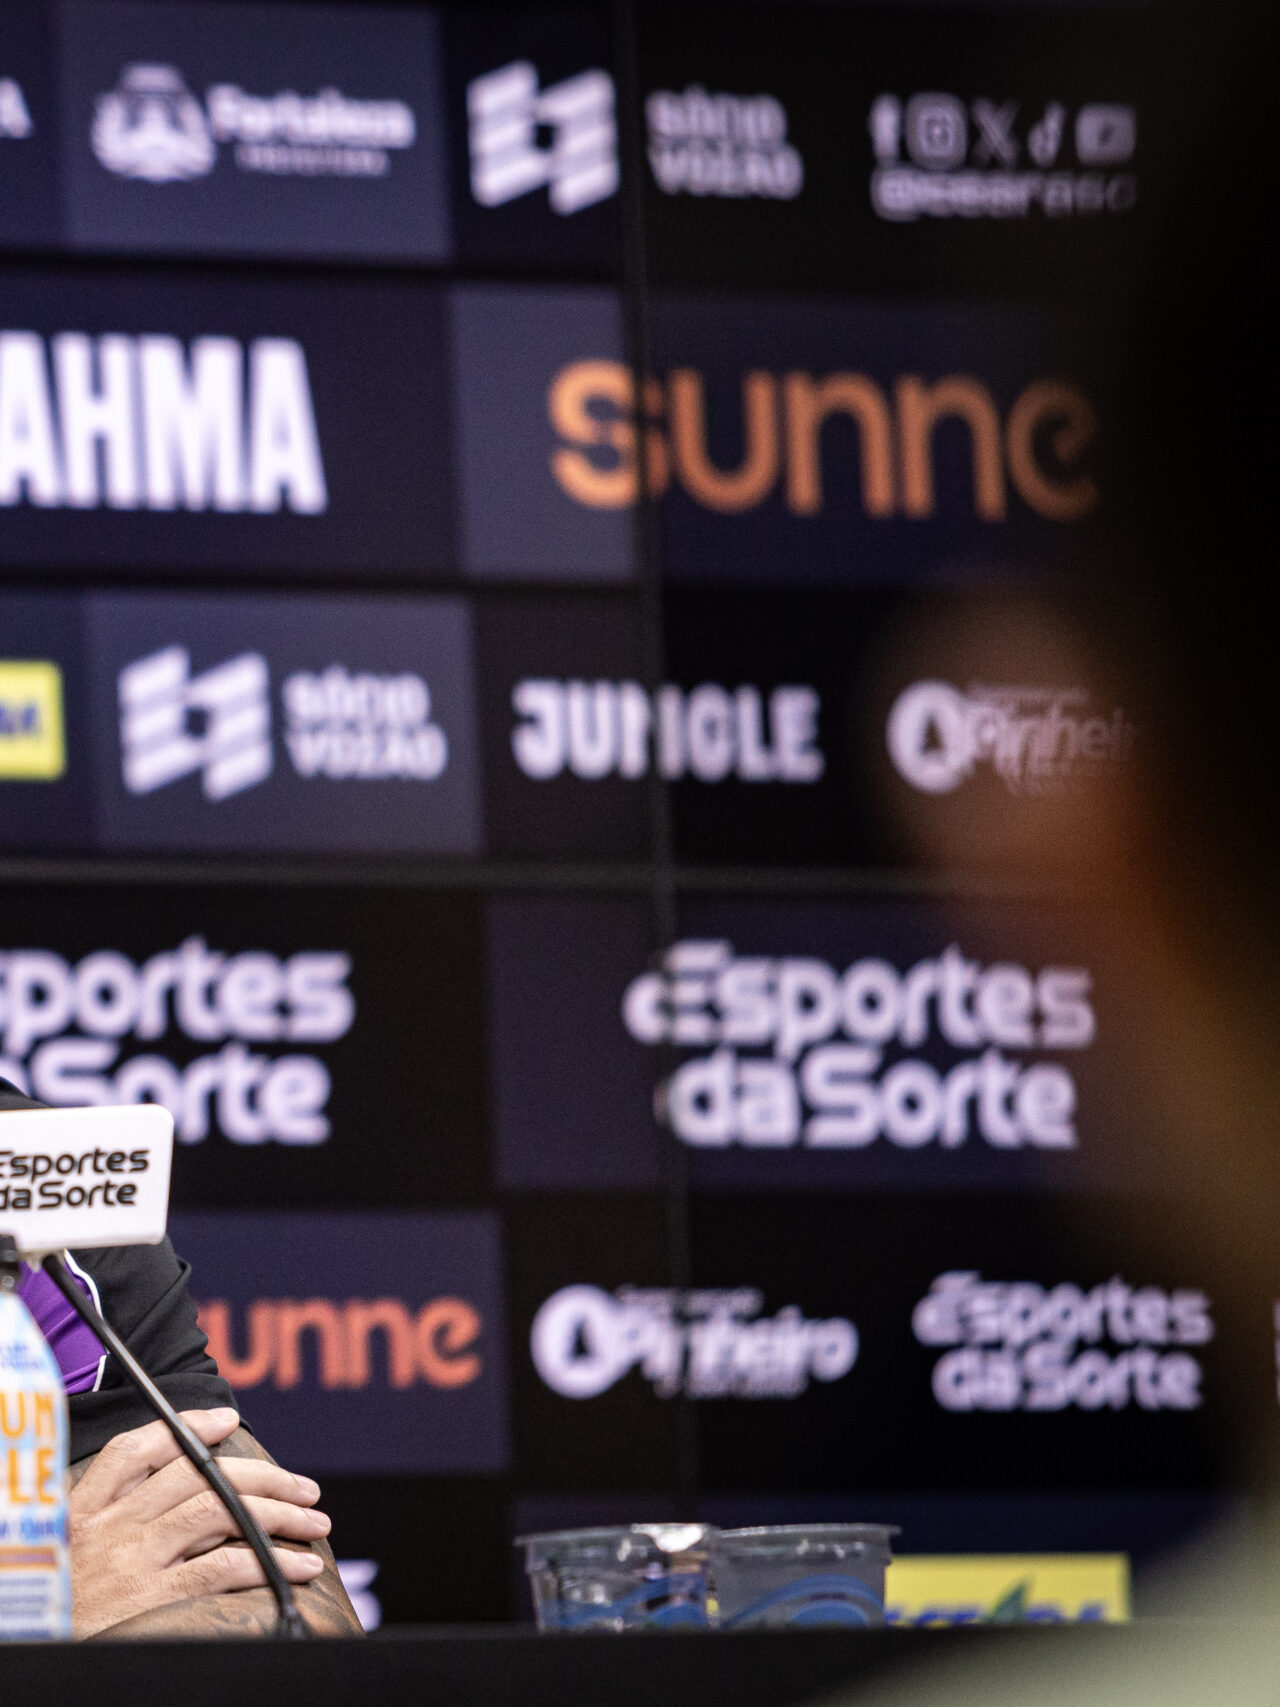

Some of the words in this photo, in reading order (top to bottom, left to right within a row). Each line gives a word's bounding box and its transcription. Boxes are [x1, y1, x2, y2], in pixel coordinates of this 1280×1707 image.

[548, 358, 1100, 522] sunne
[513, 680, 823, 783] JUNGLE
[623, 938, 1095, 1060] Esportes
[196, 1297, 482, 1390] unne
[911, 1269, 1215, 1346] Esportes
